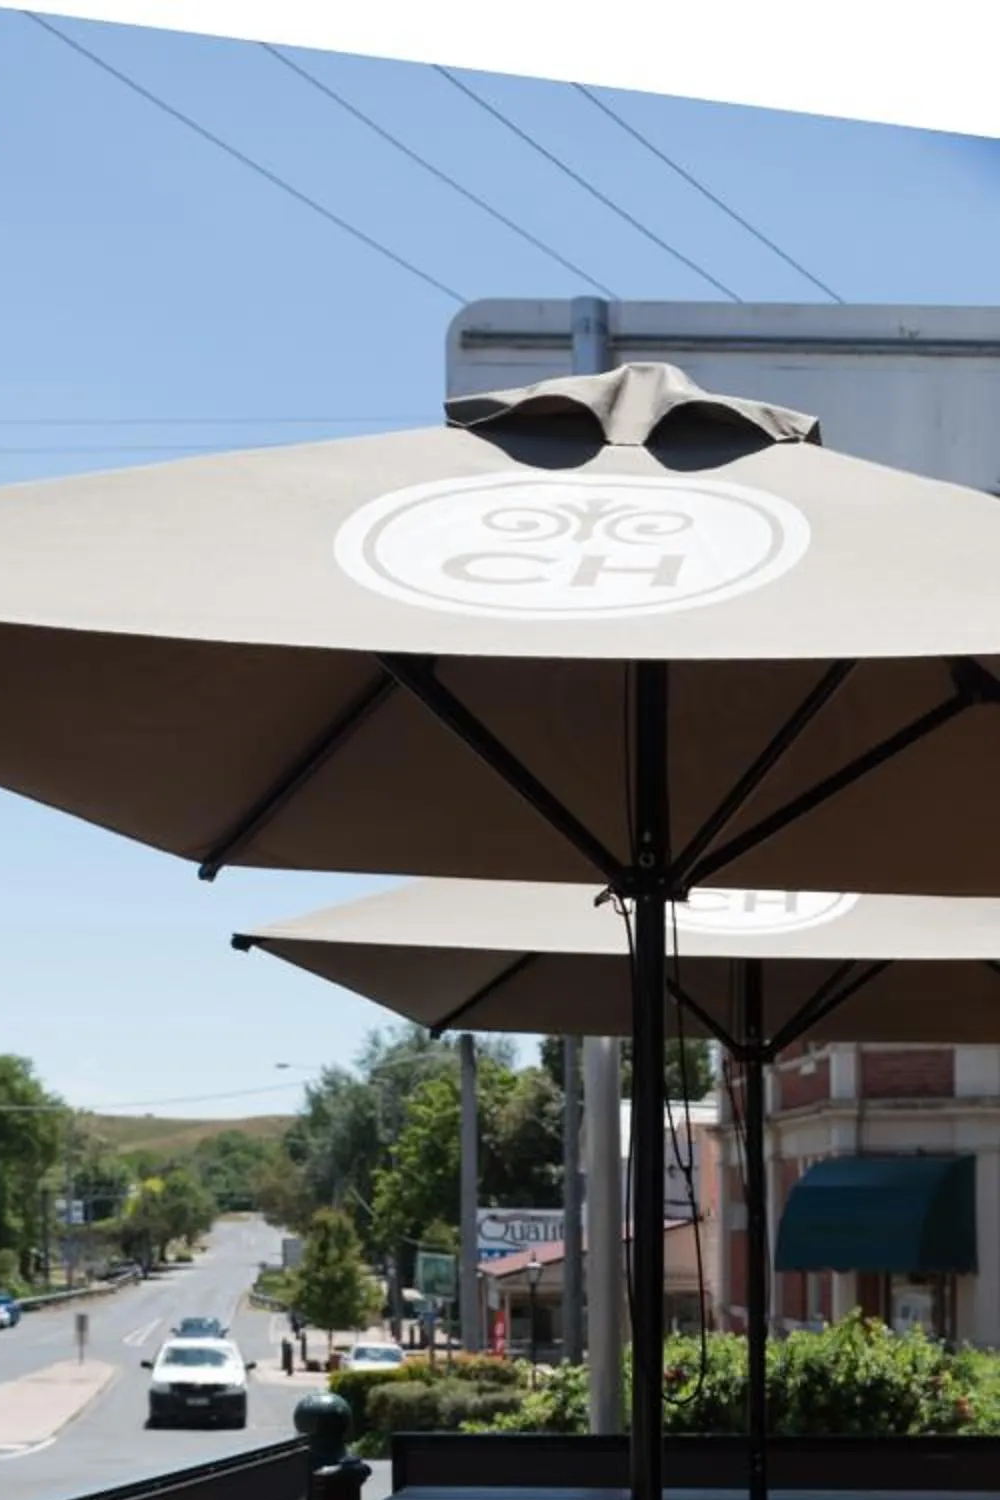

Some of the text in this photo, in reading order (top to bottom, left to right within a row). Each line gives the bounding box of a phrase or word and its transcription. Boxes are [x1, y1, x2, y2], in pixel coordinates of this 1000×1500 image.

[440, 552, 687, 587] CH
[680, 890, 797, 912] CH
[478, 1212, 564, 1247] Qualit
